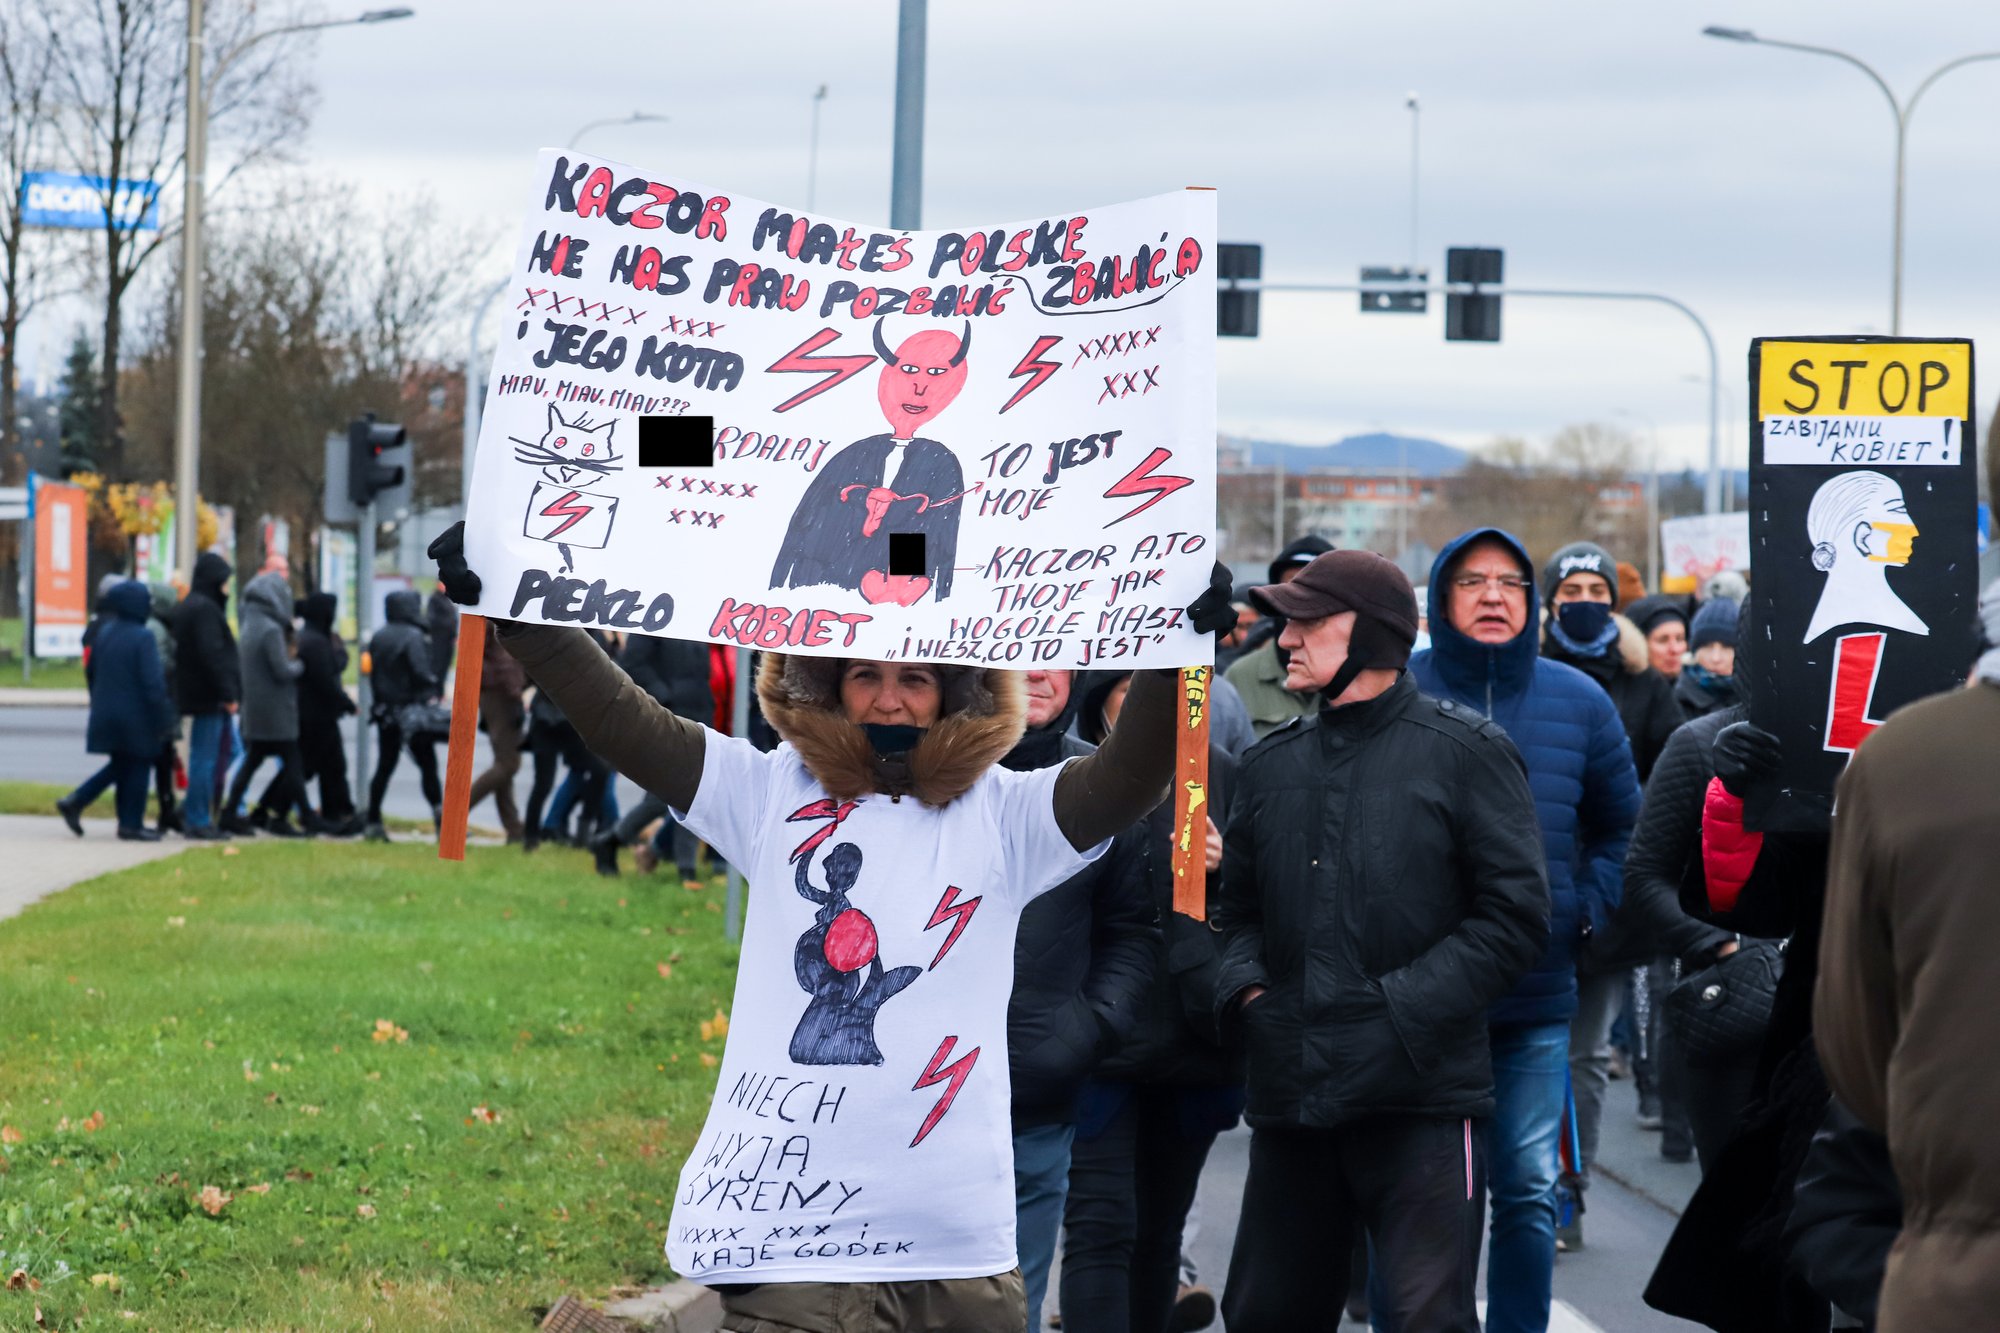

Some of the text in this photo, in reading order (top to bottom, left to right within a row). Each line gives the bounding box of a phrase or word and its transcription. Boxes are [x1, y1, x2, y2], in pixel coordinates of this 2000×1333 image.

[545, 156, 731, 241] KACZOR
[753, 207, 913, 273] MIAŁEŚ
[528, 230, 1014, 319] NIE NAS PRAW POZBAWIĆ
[533, 318, 628, 373] JEGO
[634, 335, 744, 392] KOTA
[1783, 358, 1951, 415] STOP
[712, 425, 831, 472] RDALAJ
[980, 430, 1123, 484] TO JEST
[1769, 420, 1882, 447] ZABIJANIU
[979, 486, 1061, 521] MOJE
[983, 545, 1117, 583] KACZOR
[991, 568, 1166, 614] TWOJE JAK
[708, 597, 874, 649] KOBIET
[1097, 604, 1185, 635] MASZ
[1030, 639, 1063, 662] TO
[728, 1071, 847, 1124] NIECH
[703, 1131, 811, 1182] WYJĄ
[691, 1241, 914, 1270] KAJE GODEK
